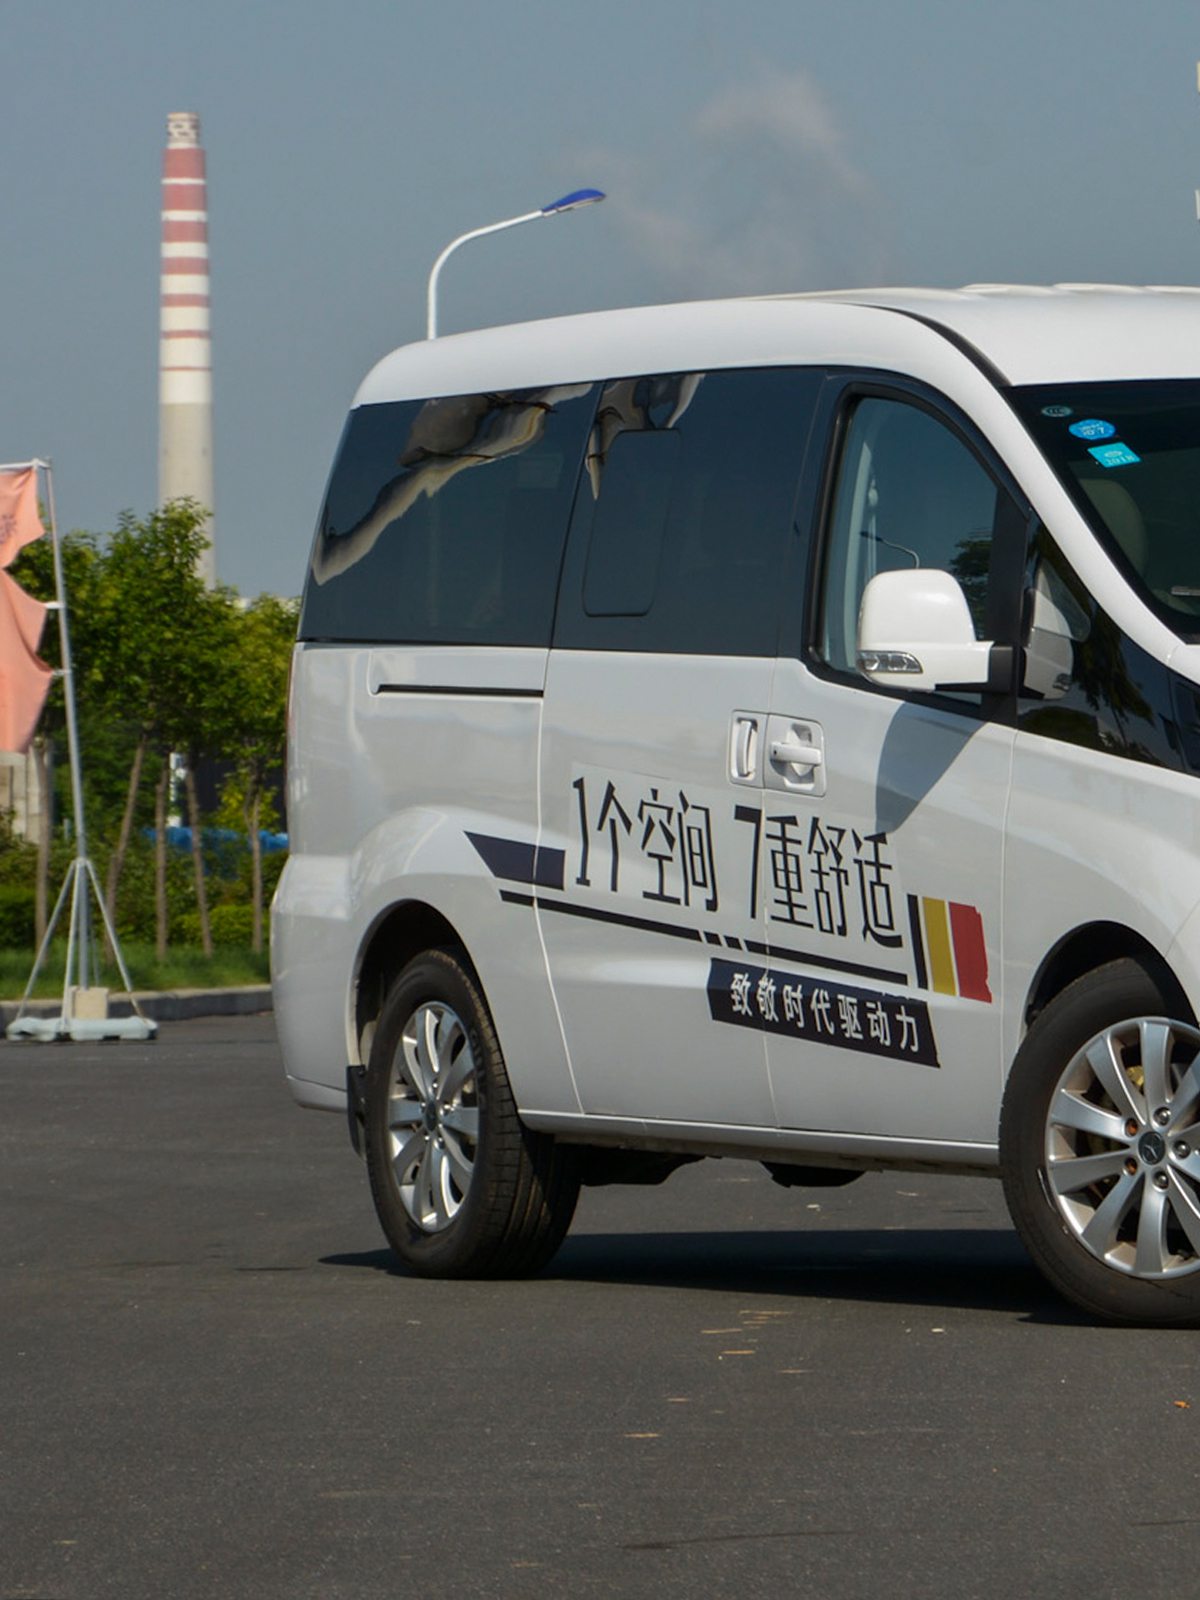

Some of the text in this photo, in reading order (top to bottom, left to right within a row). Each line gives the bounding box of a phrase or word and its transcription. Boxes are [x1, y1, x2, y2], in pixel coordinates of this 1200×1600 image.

[573, 777, 903, 949] 1个空间 7重舒适
[730, 971, 919, 1052] 致敬时代驱动力
